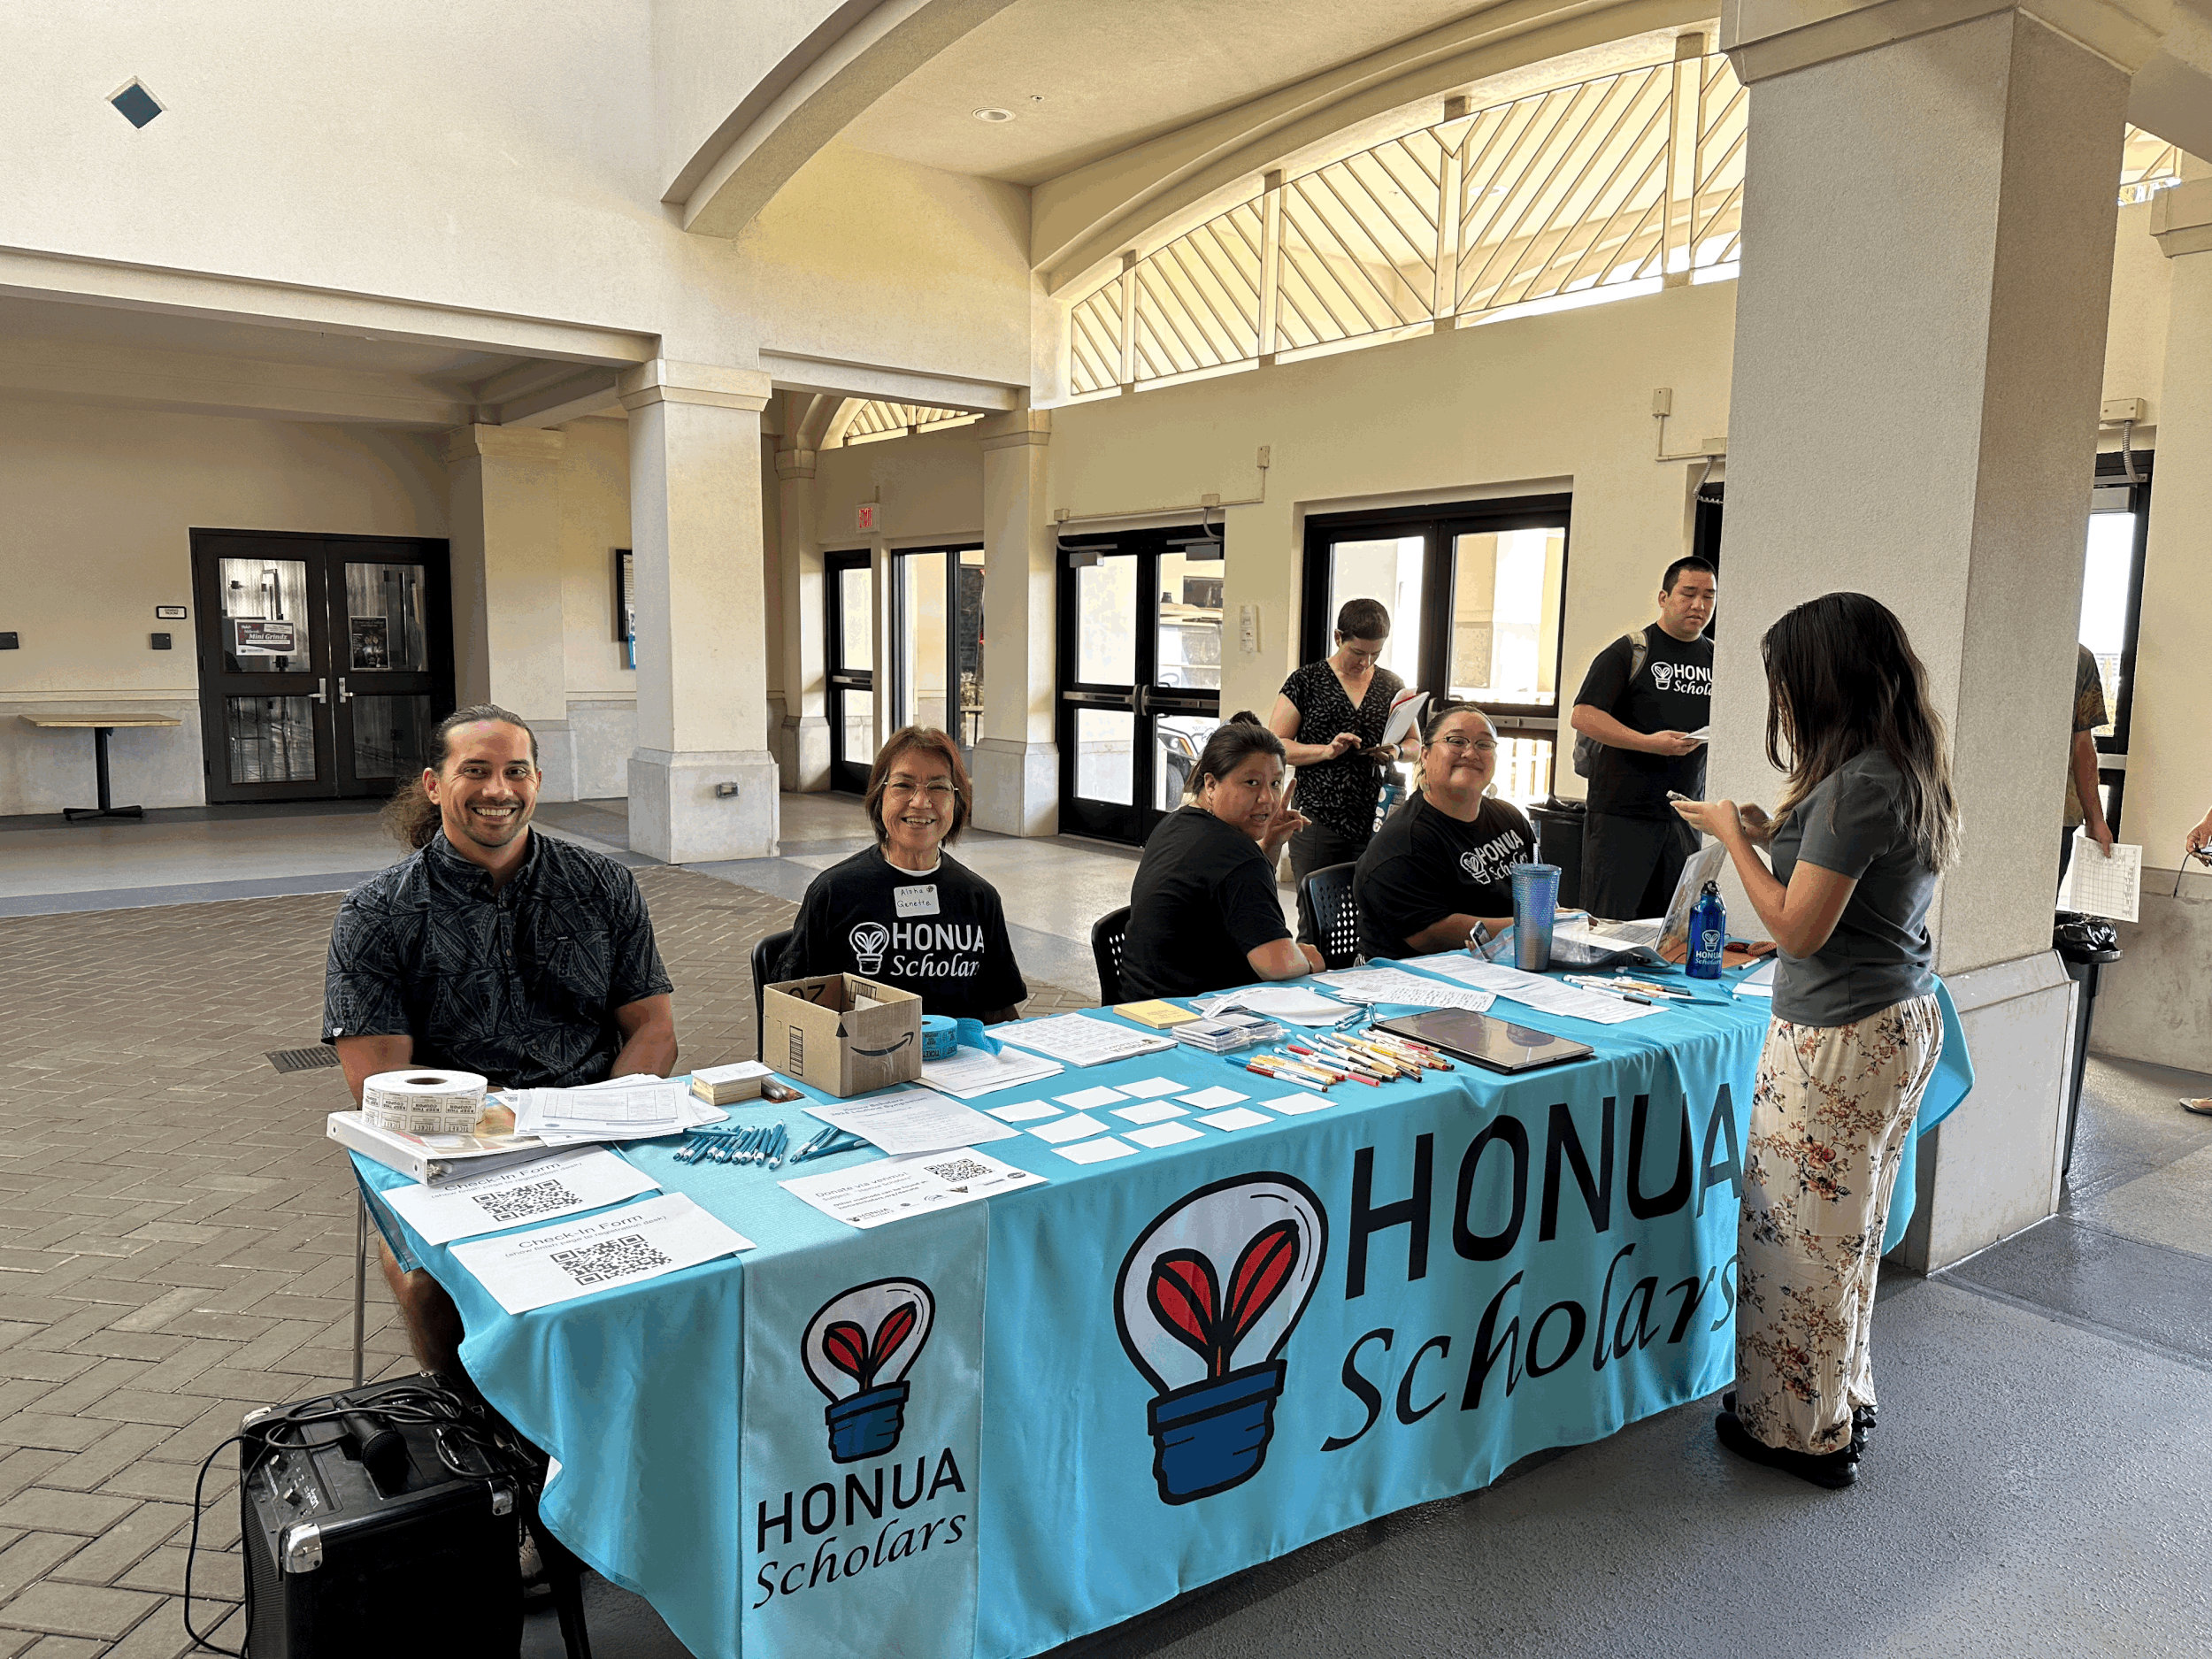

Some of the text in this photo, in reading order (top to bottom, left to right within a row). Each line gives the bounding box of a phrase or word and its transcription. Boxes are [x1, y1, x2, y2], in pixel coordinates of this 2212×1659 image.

[1473, 829, 1525, 865] HONUA
[901, 887, 924, 896] Aloha
[892, 922, 985, 954] HONUA
[444, 1163, 561, 1192] Check-In Form
[514, 1167, 559, 1183] registration
[815, 1187, 853, 1197] Donate
[1345, 1083, 1741, 1301] HONUA
[504, 1248, 532, 1258] (show
[534, 1242, 558, 1251] finish
[559, 1237, 582, 1247] page
[594, 1222, 641, 1237] registration
[642, 1216, 667, 1225] desk)
[518, 1214, 643, 1248] Check-In Form
[1320, 1243, 1739, 1452] Scholars
[757, 1447, 966, 1555] HONUA
[752, 1514, 966, 1609] Scholars
